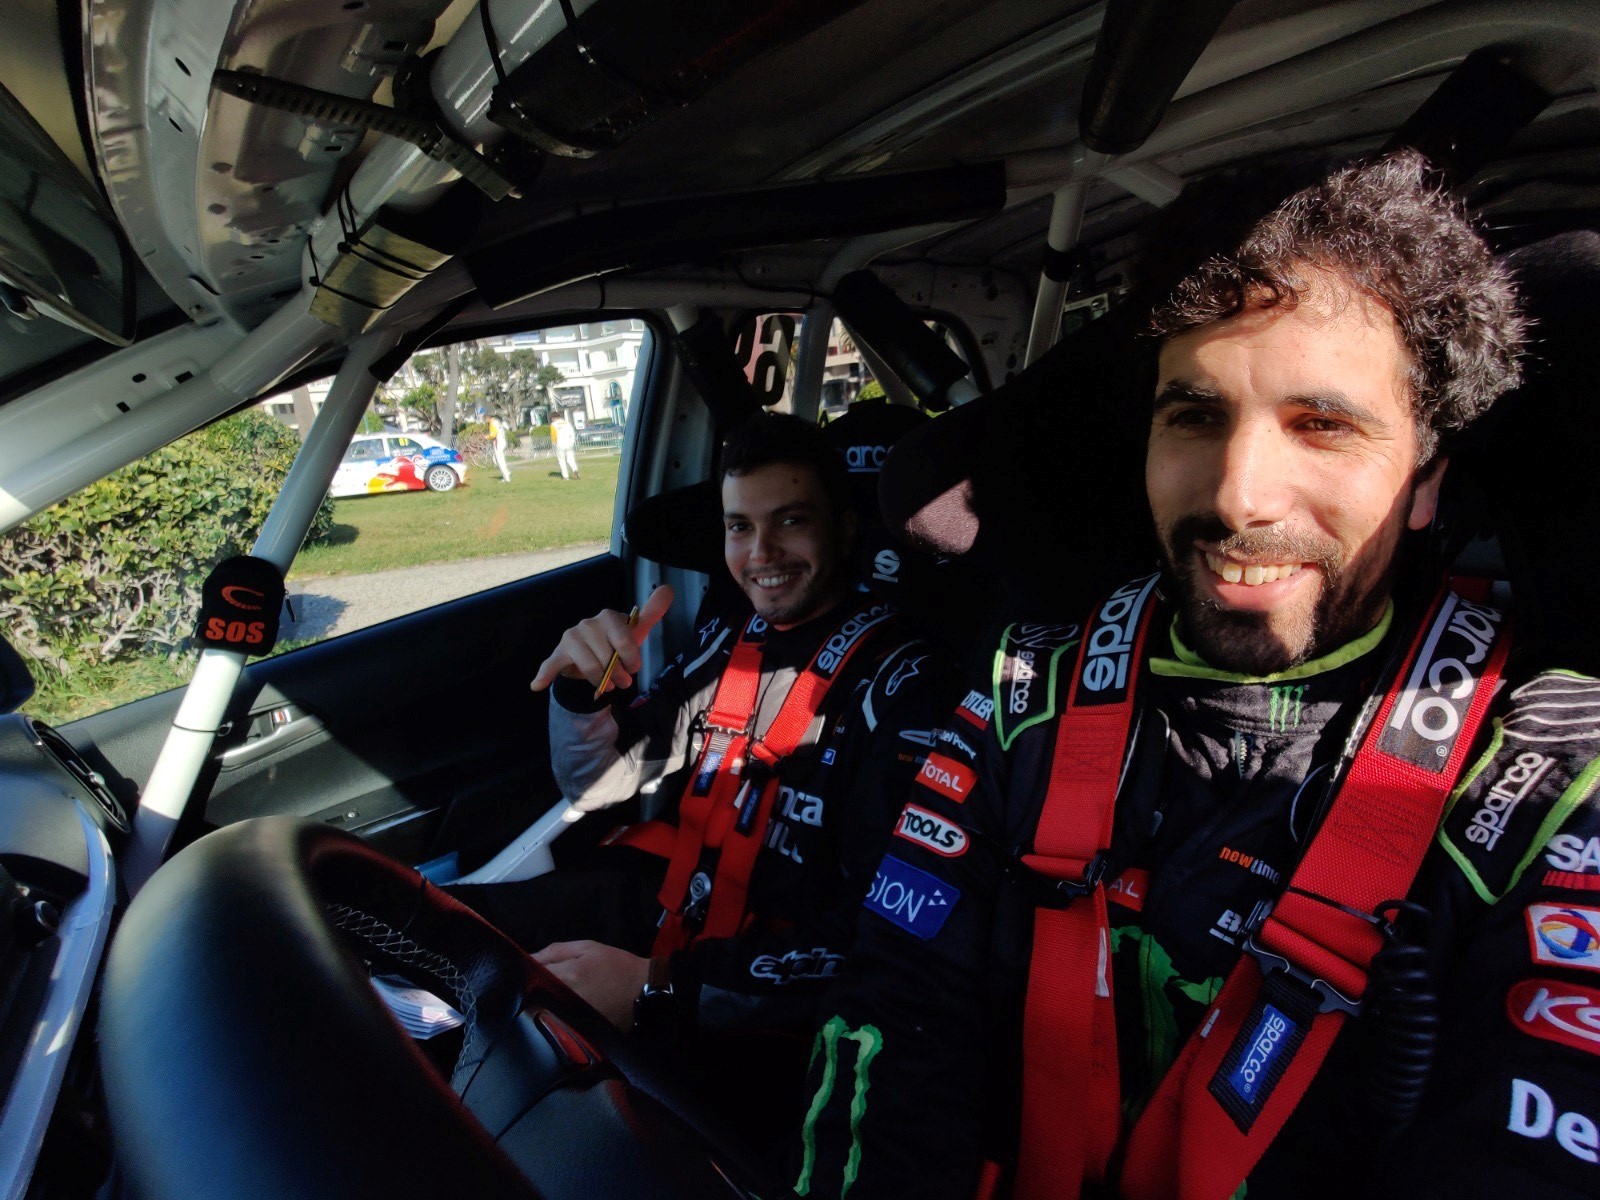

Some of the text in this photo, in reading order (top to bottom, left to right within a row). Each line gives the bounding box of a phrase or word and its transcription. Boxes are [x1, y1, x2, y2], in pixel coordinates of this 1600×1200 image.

[205, 617, 265, 644] SOS
[1011, 651, 1036, 714] sparco
[922, 758, 963, 793] TOTAL
[1465, 752, 1545, 846] sparco
[905, 812, 958, 847] TOOLS
[1244, 1017, 1285, 1083] sparco
[1506, 1077, 1600, 1164] De
